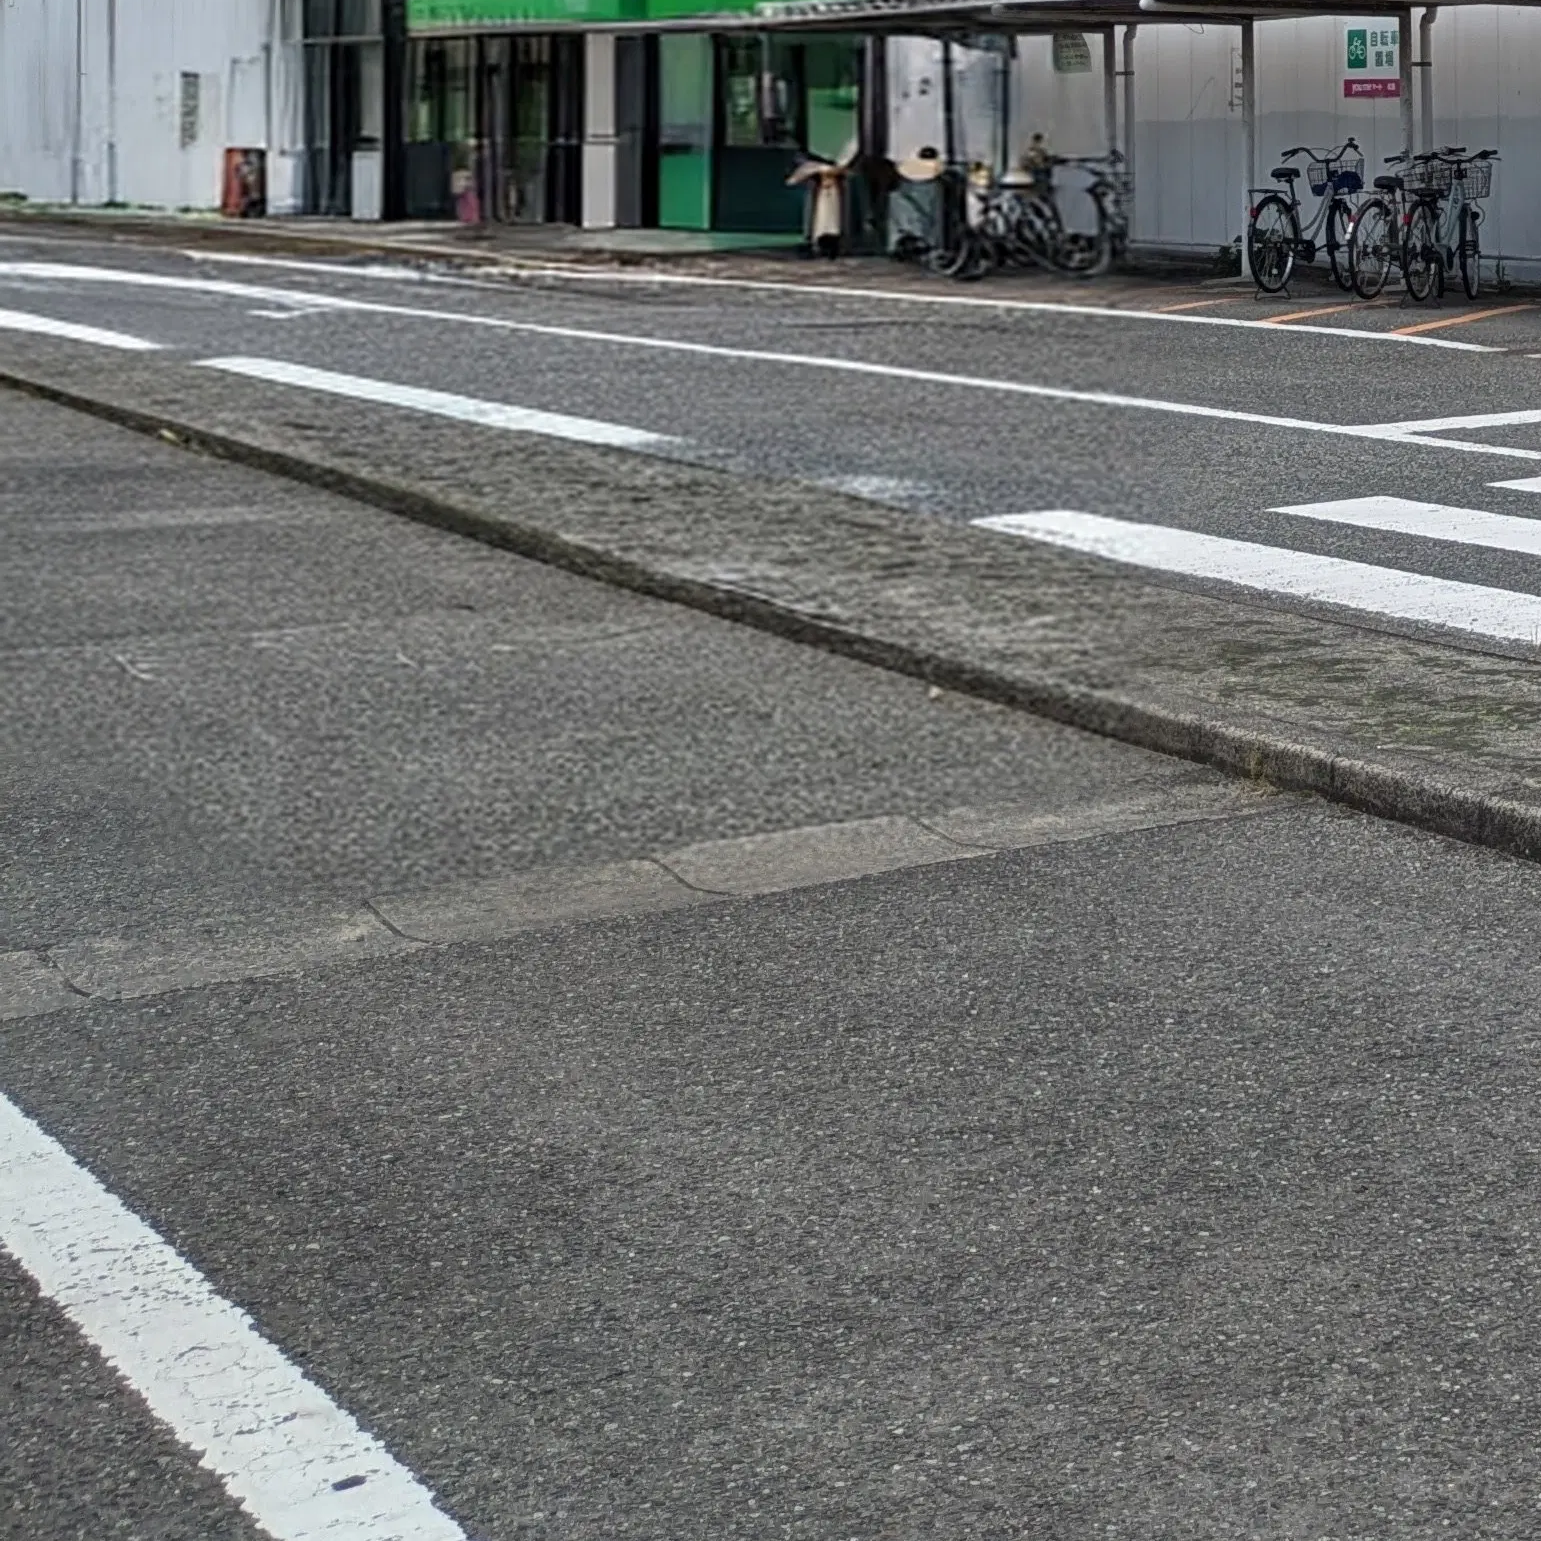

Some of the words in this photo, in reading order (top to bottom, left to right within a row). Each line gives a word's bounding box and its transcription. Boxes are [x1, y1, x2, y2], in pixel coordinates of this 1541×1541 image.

[1370, 31, 1399, 46] 自転車
[1375, 51, 1394, 67] 置場
